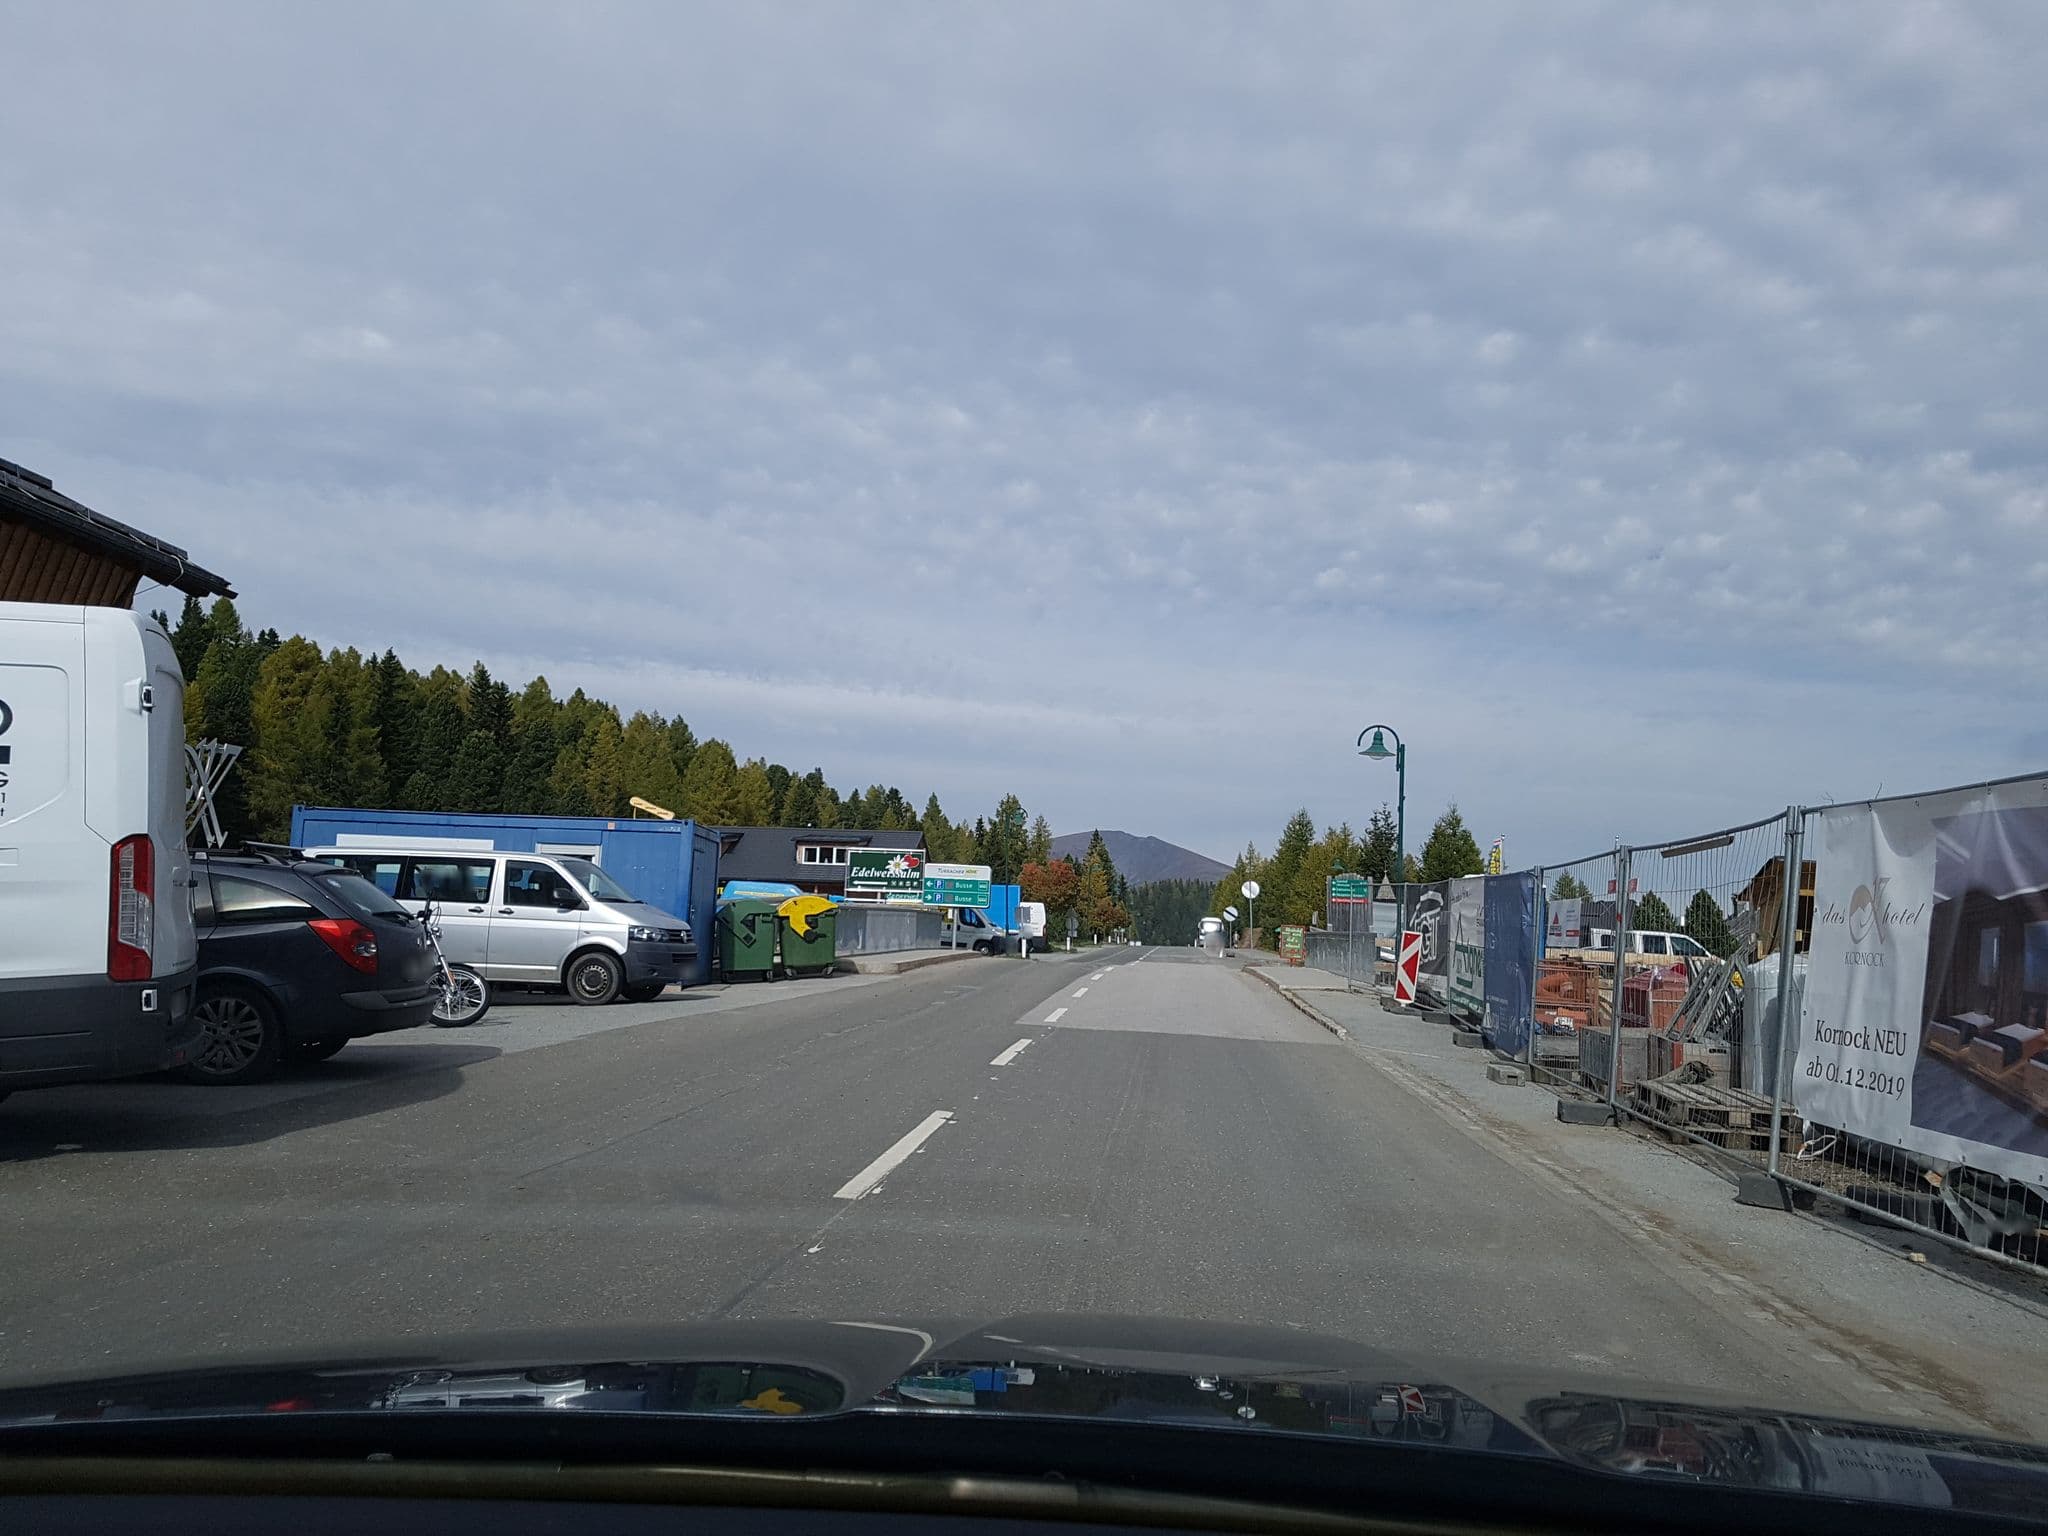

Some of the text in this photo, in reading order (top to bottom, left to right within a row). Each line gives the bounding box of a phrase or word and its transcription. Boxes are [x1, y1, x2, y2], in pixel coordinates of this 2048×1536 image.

[955, 881, 973, 889] Busse
[1822, 903, 1846, 925] das
[1844, 951, 1885, 967] KORNOCK
[1815, 1019, 1907, 1056] Kornock NEU
[1806, 1056, 1905, 1101] ab 01.12.2019
